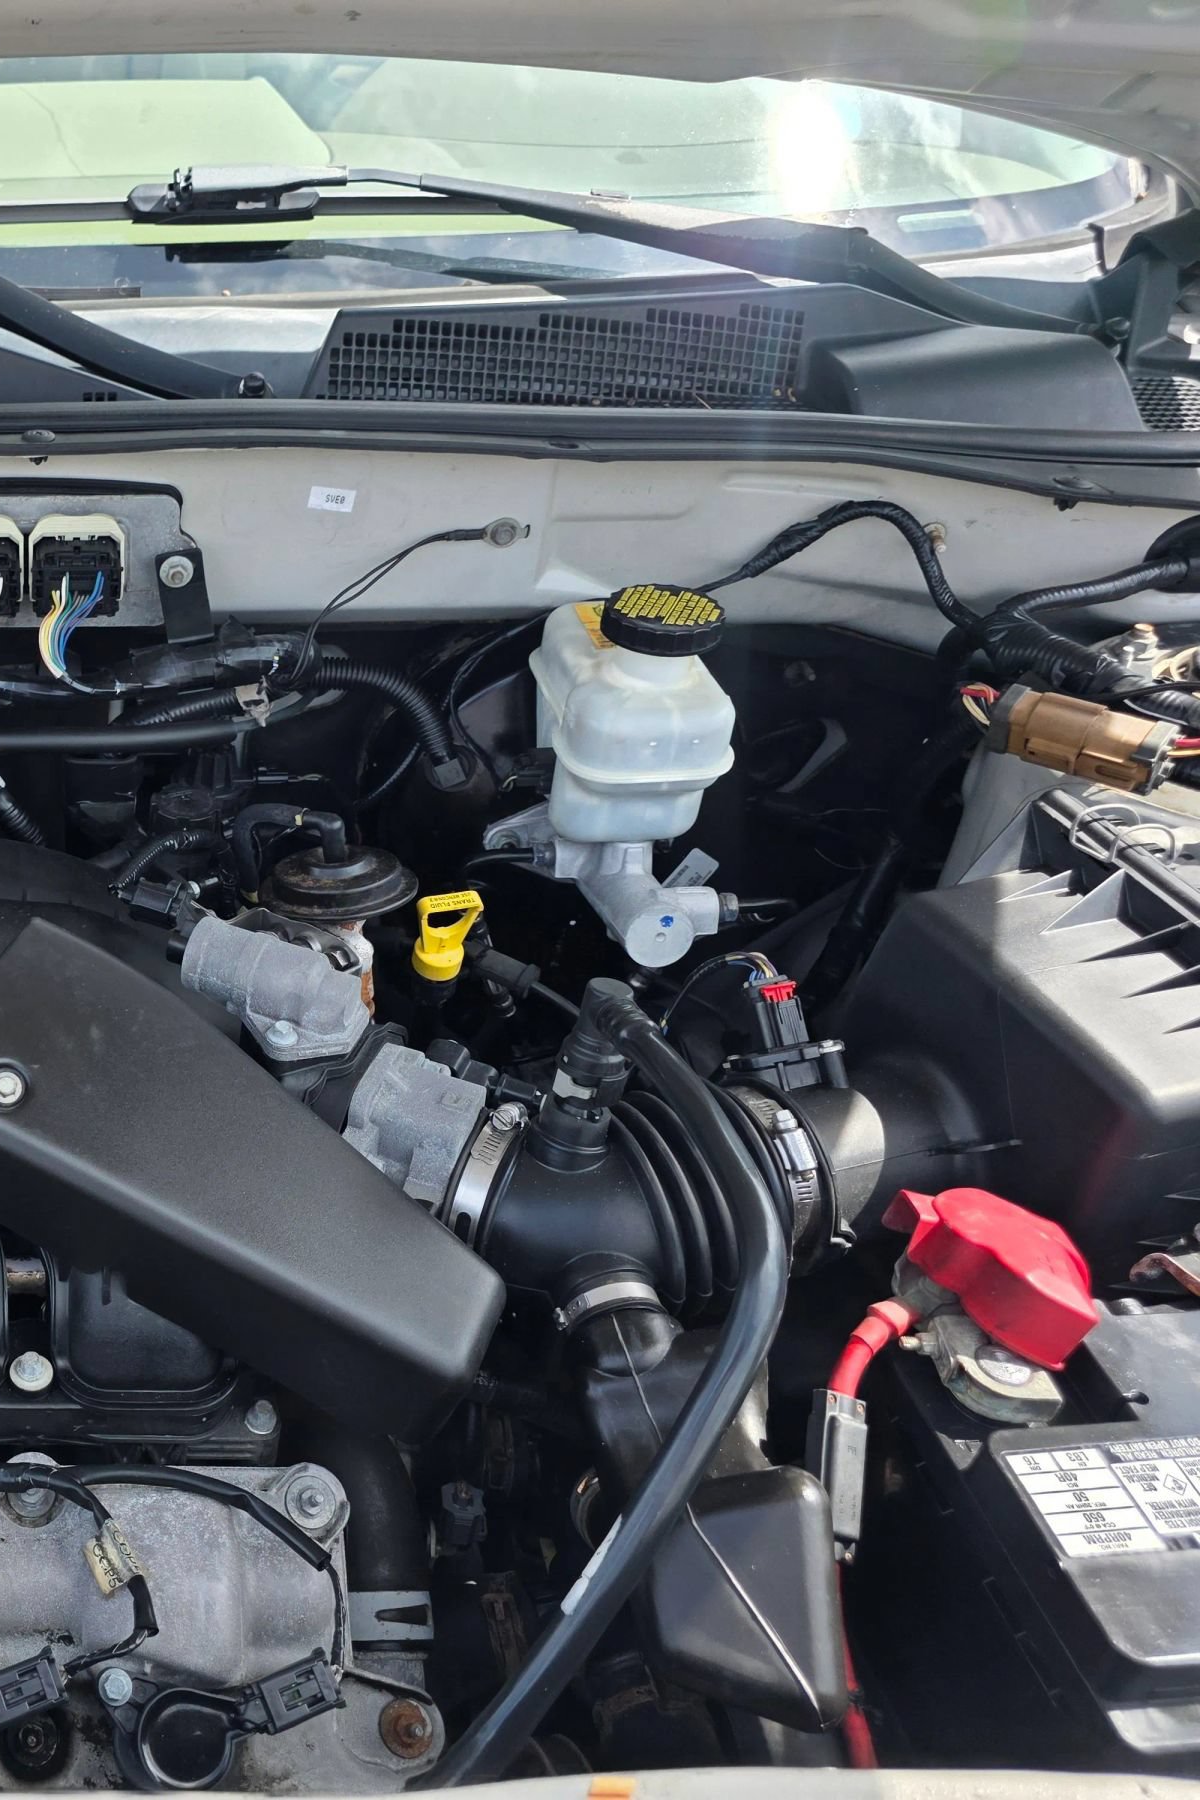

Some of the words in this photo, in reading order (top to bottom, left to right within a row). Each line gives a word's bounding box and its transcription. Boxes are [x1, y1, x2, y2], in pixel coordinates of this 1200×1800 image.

[430, 901, 451, 909] FLUID
[452, 898, 476, 906] TRANS
[1104, 1441, 1146, 1453] BATTERY.
[1144, 1440, 1169, 1450] OPEN
[1167, 1438, 1188, 1449] NOT
[1022, 1455, 1038, 1466] T6
[1117, 1451, 1135, 1461] ALL
[1135, 1451, 1158, 1460] READ
[1115, 1465, 1139, 1474] FAST.
[1139, 1463, 1160, 1472] HELP
[1054, 1472, 1079, 1483] 40R
[1123, 1473, 1160, 1483] MEDICAL
[1140, 1482, 1158, 1491] GET
[1072, 1491, 1090, 1502] 50
[1145, 1500, 1177, 1510] WATER.
[1174, 1498, 1199, 1508] WITH
[1082, 1512, 1106, 1523] 650
[1164, 1519, 1187, 1529] EYES
